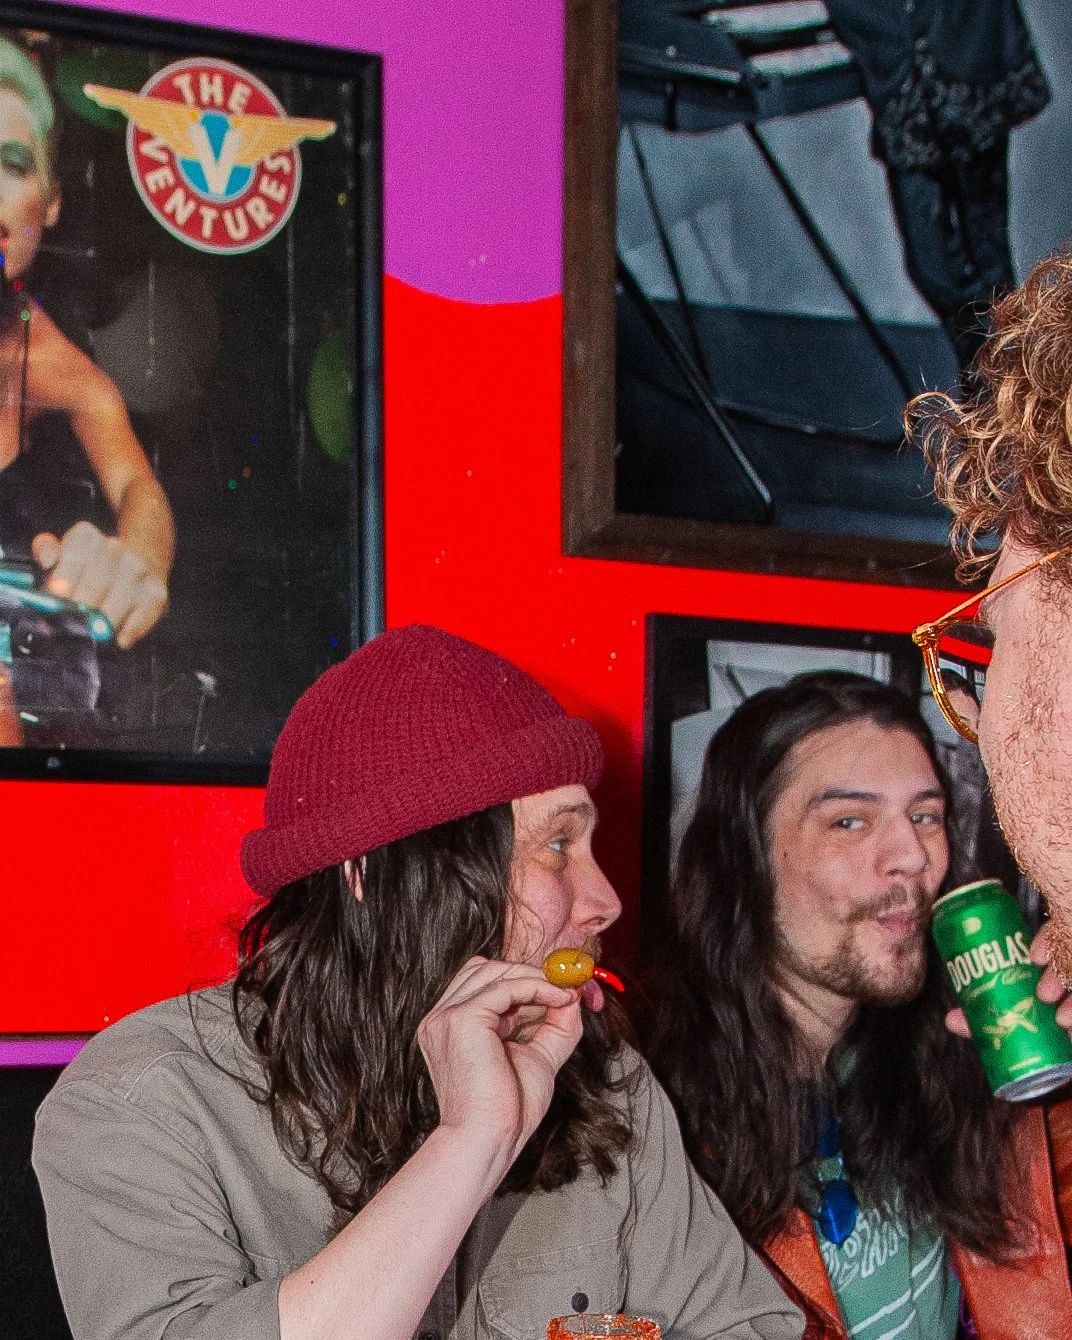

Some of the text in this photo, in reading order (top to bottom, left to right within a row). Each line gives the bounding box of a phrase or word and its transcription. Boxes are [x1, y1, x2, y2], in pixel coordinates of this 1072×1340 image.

[173, 73, 252, 116] THE
[139, 136, 293, 241] VENTURES
[946, 931, 1032, 993] DOUGLAS
